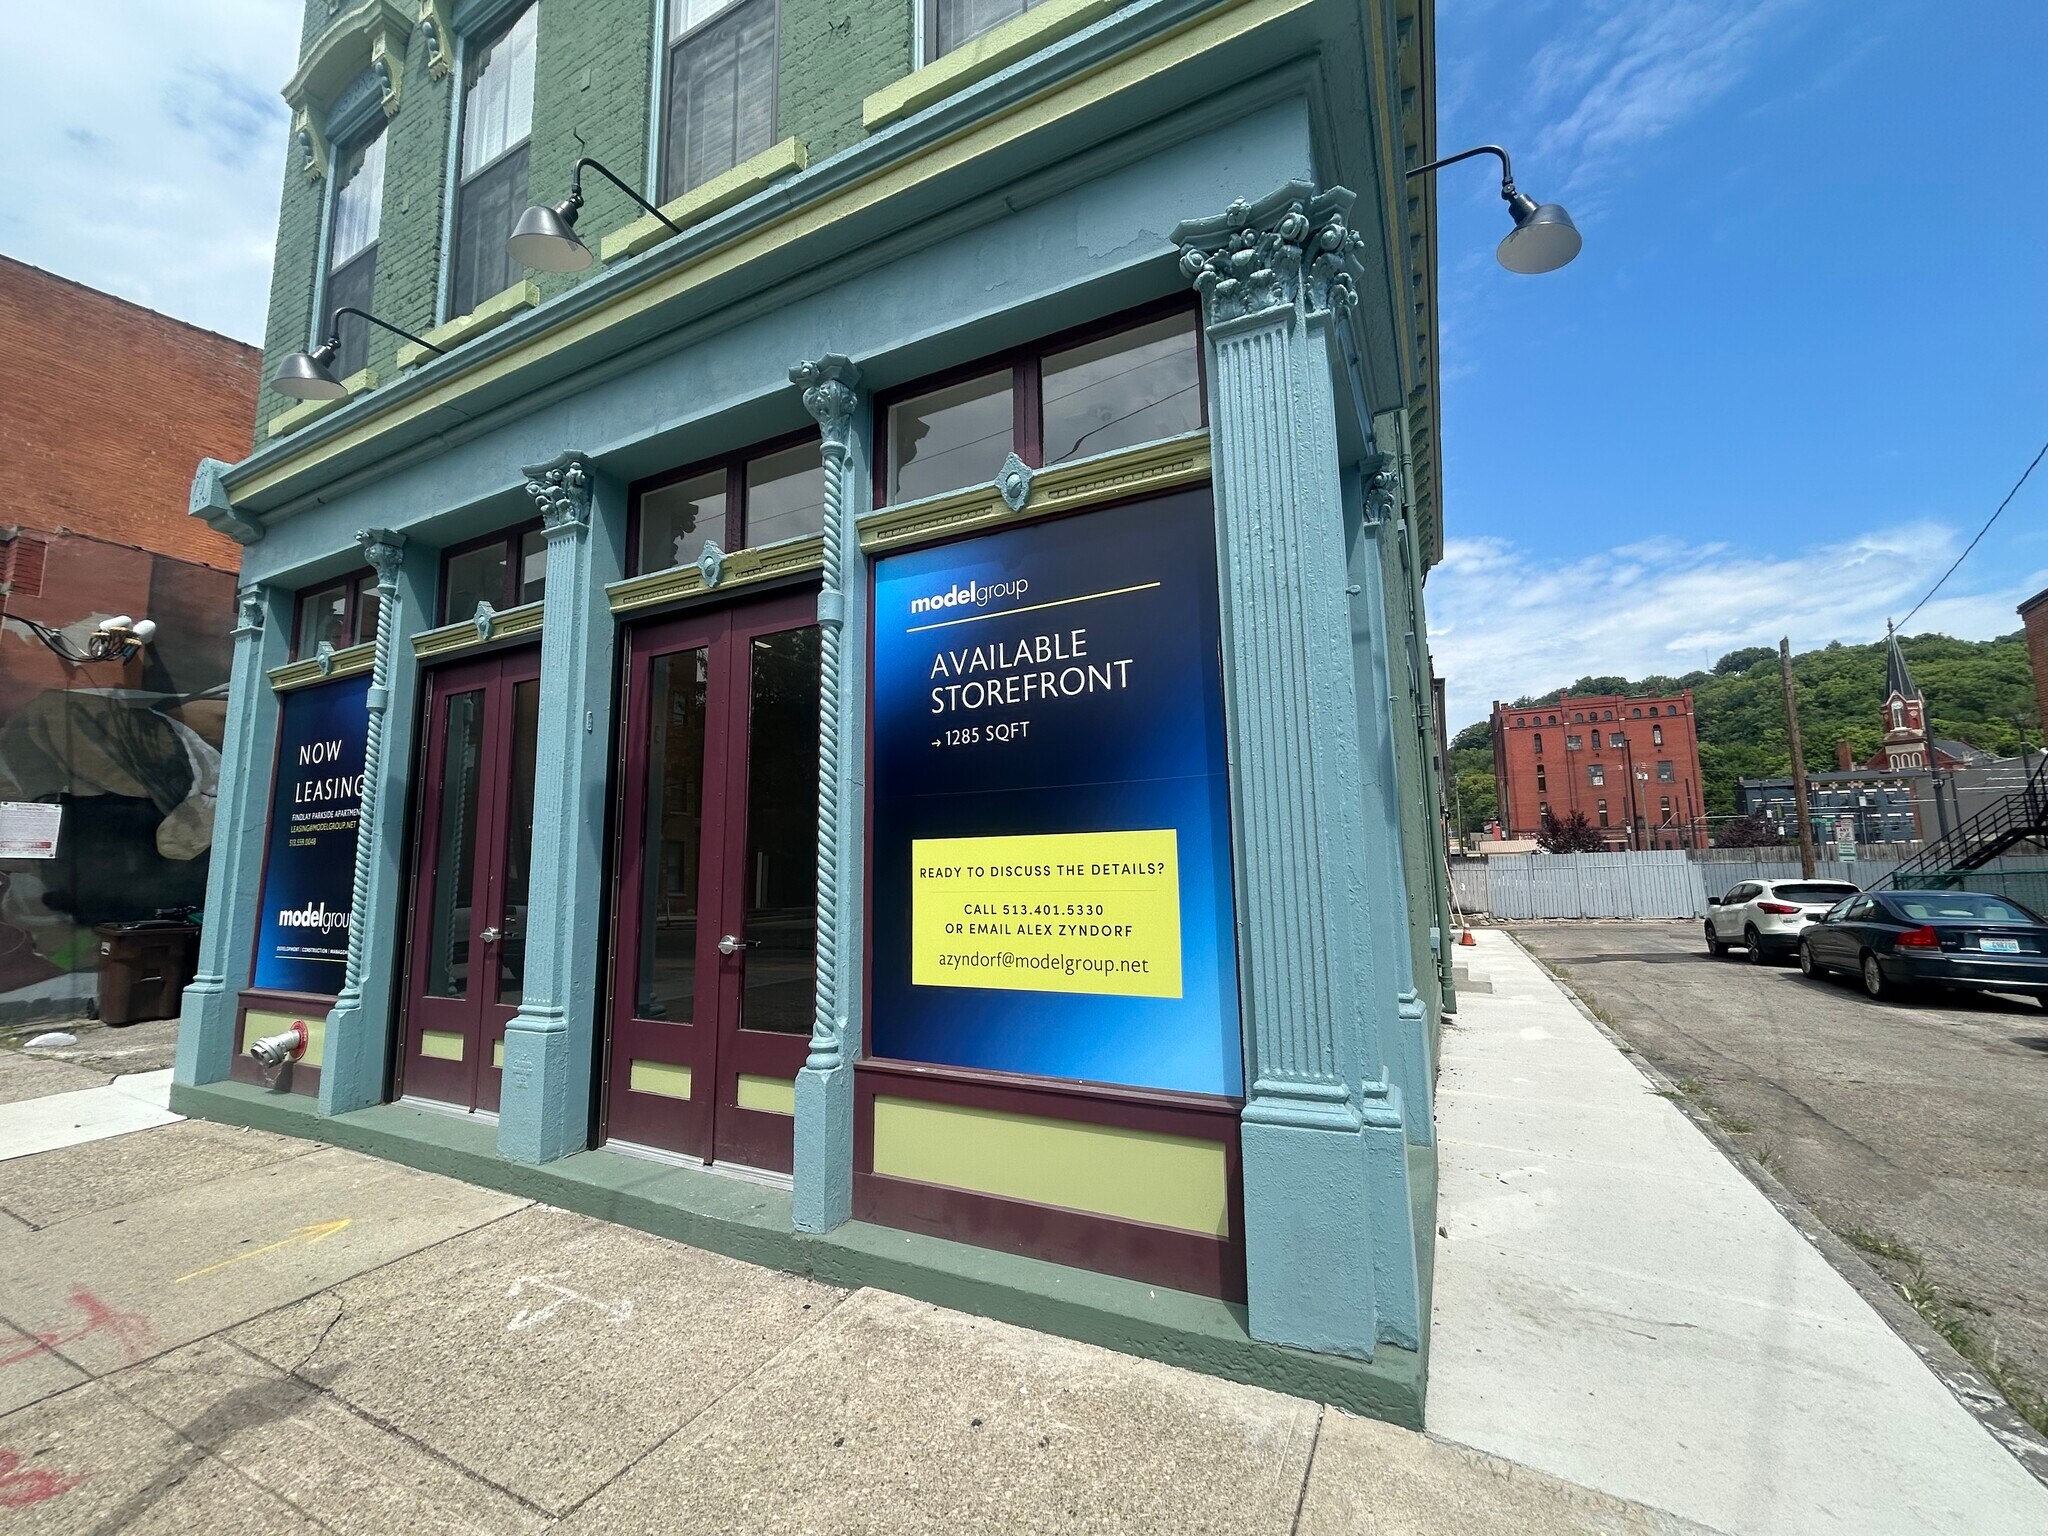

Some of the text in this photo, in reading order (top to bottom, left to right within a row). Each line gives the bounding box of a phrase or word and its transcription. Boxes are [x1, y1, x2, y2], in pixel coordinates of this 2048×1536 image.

[911, 578, 1029, 614] modelgroup
[930, 628, 1088, 680] AVAILABLE
[931, 658, 1134, 714] STOREFRONT
[945, 721, 1030, 746] 1285 SQFT
[299, 739, 342, 766] NOW
[295, 774, 365, 803] LEASING
[291, 808, 361, 821] FINDLAY PARKSIDE APARTMEN
[920, 862, 1165, 879] READY TO DISCUSS THE DETAILS?
[964, 904, 1104, 916] CALL 513.401.5330
[945, 923, 1133, 937] OR EMAIL ALEX ZYNDORF
[939, 951, 1149, 976] azyndorf@modelgroup.net
